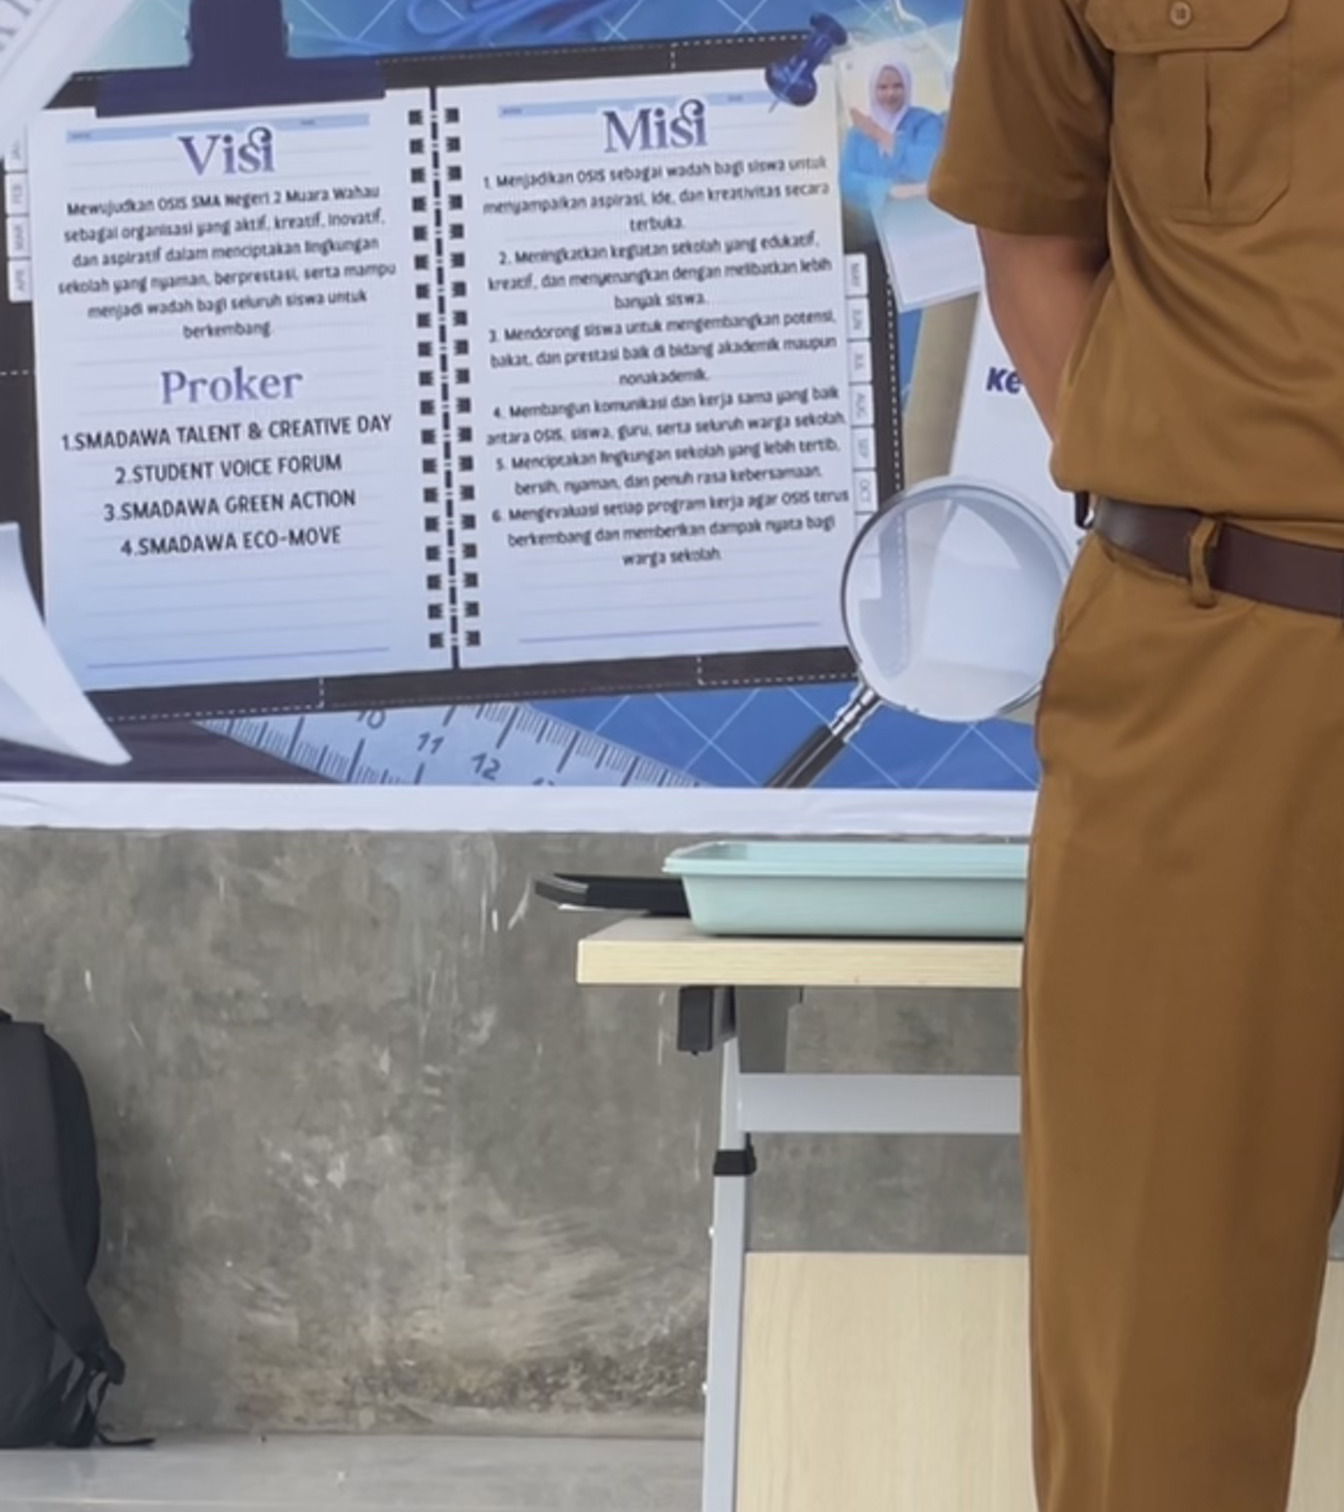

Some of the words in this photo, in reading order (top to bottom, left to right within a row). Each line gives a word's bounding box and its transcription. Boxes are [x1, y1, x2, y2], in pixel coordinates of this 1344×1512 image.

[603, 99, 707, 153] Misi
[178, 126, 274, 175] Visi
[497, 170, 573, 190] Menjadikan
[577, 169, 606, 183] OSIS
[610, 165, 662, 184] sebagai
[666, 162, 711, 177] wadah
[715, 160, 744, 176] bagi
[748, 159, 785, 173] siswa
[789, 156, 826, 170] untuk
[67, 199, 154, 217] Mewujudkan
[158, 195, 187, 210] OSIS
[191, 193, 221, 209] SMA
[225, 190, 270, 209] Negeri
[273, 191, 282, 204] 2
[286, 187, 329, 203] Muara
[333, 186, 379, 200] Wahau
[483, 196, 587, 215] menyampaikan
[679, 189, 704, 204] dan
[708, 185, 781, 201] kreativitas
[785, 183, 829, 196] secara
[64, 226, 118, 243] sebagai
[122, 222, 193, 240] organisasi
[197, 221, 230, 238] yang
[72, 252, 98, 267] dan
[102, 247, 162, 269] aspiratif
[166, 245, 208, 262] dalam
[212, 240, 301, 262] menciptakan
[304, 237, 379, 254] lingkungan
[515, 246, 608, 266] Meningkatkan
[611, 242, 667, 261] kegiatan
[672, 240, 721, 256] sekolah
[725, 238, 757, 254] yang
[59, 279, 109, 294] sekolah
[113, 278, 146, 294] yang
[304, 266, 340, 280] serta
[344, 264, 396, 278] mampu
[541, 273, 566, 288] dan
[570, 266, 669, 287] menyenangkan
[673, 264, 721, 283] dengan
[725, 259, 797, 277] melibatkan
[800, 257, 831, 272] lebih
[88, 300, 143, 320] menjadi
[148, 297, 193, 314] wadah
[197, 296, 227, 314] bagi
[231, 293, 282, 309] seluruh
[286, 293, 324, 306] siswa
[328, 290, 367, 304] untuk
[615, 294, 661, 310] banyak
[505, 325, 580, 342] Mendorong
[584, 321, 622, 336] siswa
[626, 319, 662, 333] untuk
[666, 313, 779, 333] mengembangkan
[536, 350, 562, 365] dan
[565, 346, 619, 366] prestasi
[623, 346, 650, 359] baik
[654, 345, 665, 359] di
[669, 341, 713, 359] bidang
[718, 339, 779, 355] akademik
[783, 337, 836, 352] maupun
[161, 366, 302, 405] Proker
[510, 400, 590, 419] Membangun
[594, 396, 668, 413] komunikasi
[672, 394, 696, 409] dan
[699, 392, 734, 410] kerja
[738, 391, 772, 403] sama
[776, 389, 808, 406] yang
[812, 387, 839, 400] baik
[62, 428, 171, 451] 1.SMADAWA
[177, 423, 241, 444] TALENT
[248, 422, 262, 440] &
[268, 417, 351, 437] CREATIVE
[358, 414, 392, 432] DAY
[487, 431, 529, 446] antara
[656, 420, 692, 435] serta
[696, 417, 744, 433] seluruh
[748, 416, 791, 432] warga
[116, 461, 214, 484] 2.STUDENT
[220, 457, 271, 478] VOICE
[278, 454, 342, 474] FORUM
[511, 451, 596, 471] Menciptakan
[600, 447, 672, 467] lingkungan
[675, 444, 724, 459] sekolah
[728, 442, 761, 458] yang
[764, 439, 796, 454] lebih
[624, 474, 649, 488] dan
[653, 470, 693, 489] penuh
[697, 470, 726, 483] rasa
[104, 497, 219, 521] 3.SMADAWA
[225, 493, 283, 514] GREEN
[290, 490, 356, 509] ACTION
[509, 503, 599, 523] Mengevaluasi
[603, 500, 643, 517] setiap
[647, 498, 706, 517] program
[710, 495, 744, 513] kerja
[748, 493, 777, 510] agar
[781, 490, 810, 505] OSIS
[814, 489, 849, 503] terus
[121, 533, 238, 556] 4.SMADAWA
[243, 526, 341, 549] ECO-MOVE
[508, 529, 591, 548] berkembang
[595, 527, 620, 542] dan
[624, 522, 706, 540] memberikan
[710, 518, 761, 536] dampak
[765, 517, 802, 533] nyata
[807, 514, 835, 531] bagi
[622, 550, 666, 567] warga
[417, 731, 445, 755] 11
[471, 752, 501, 782] 12
